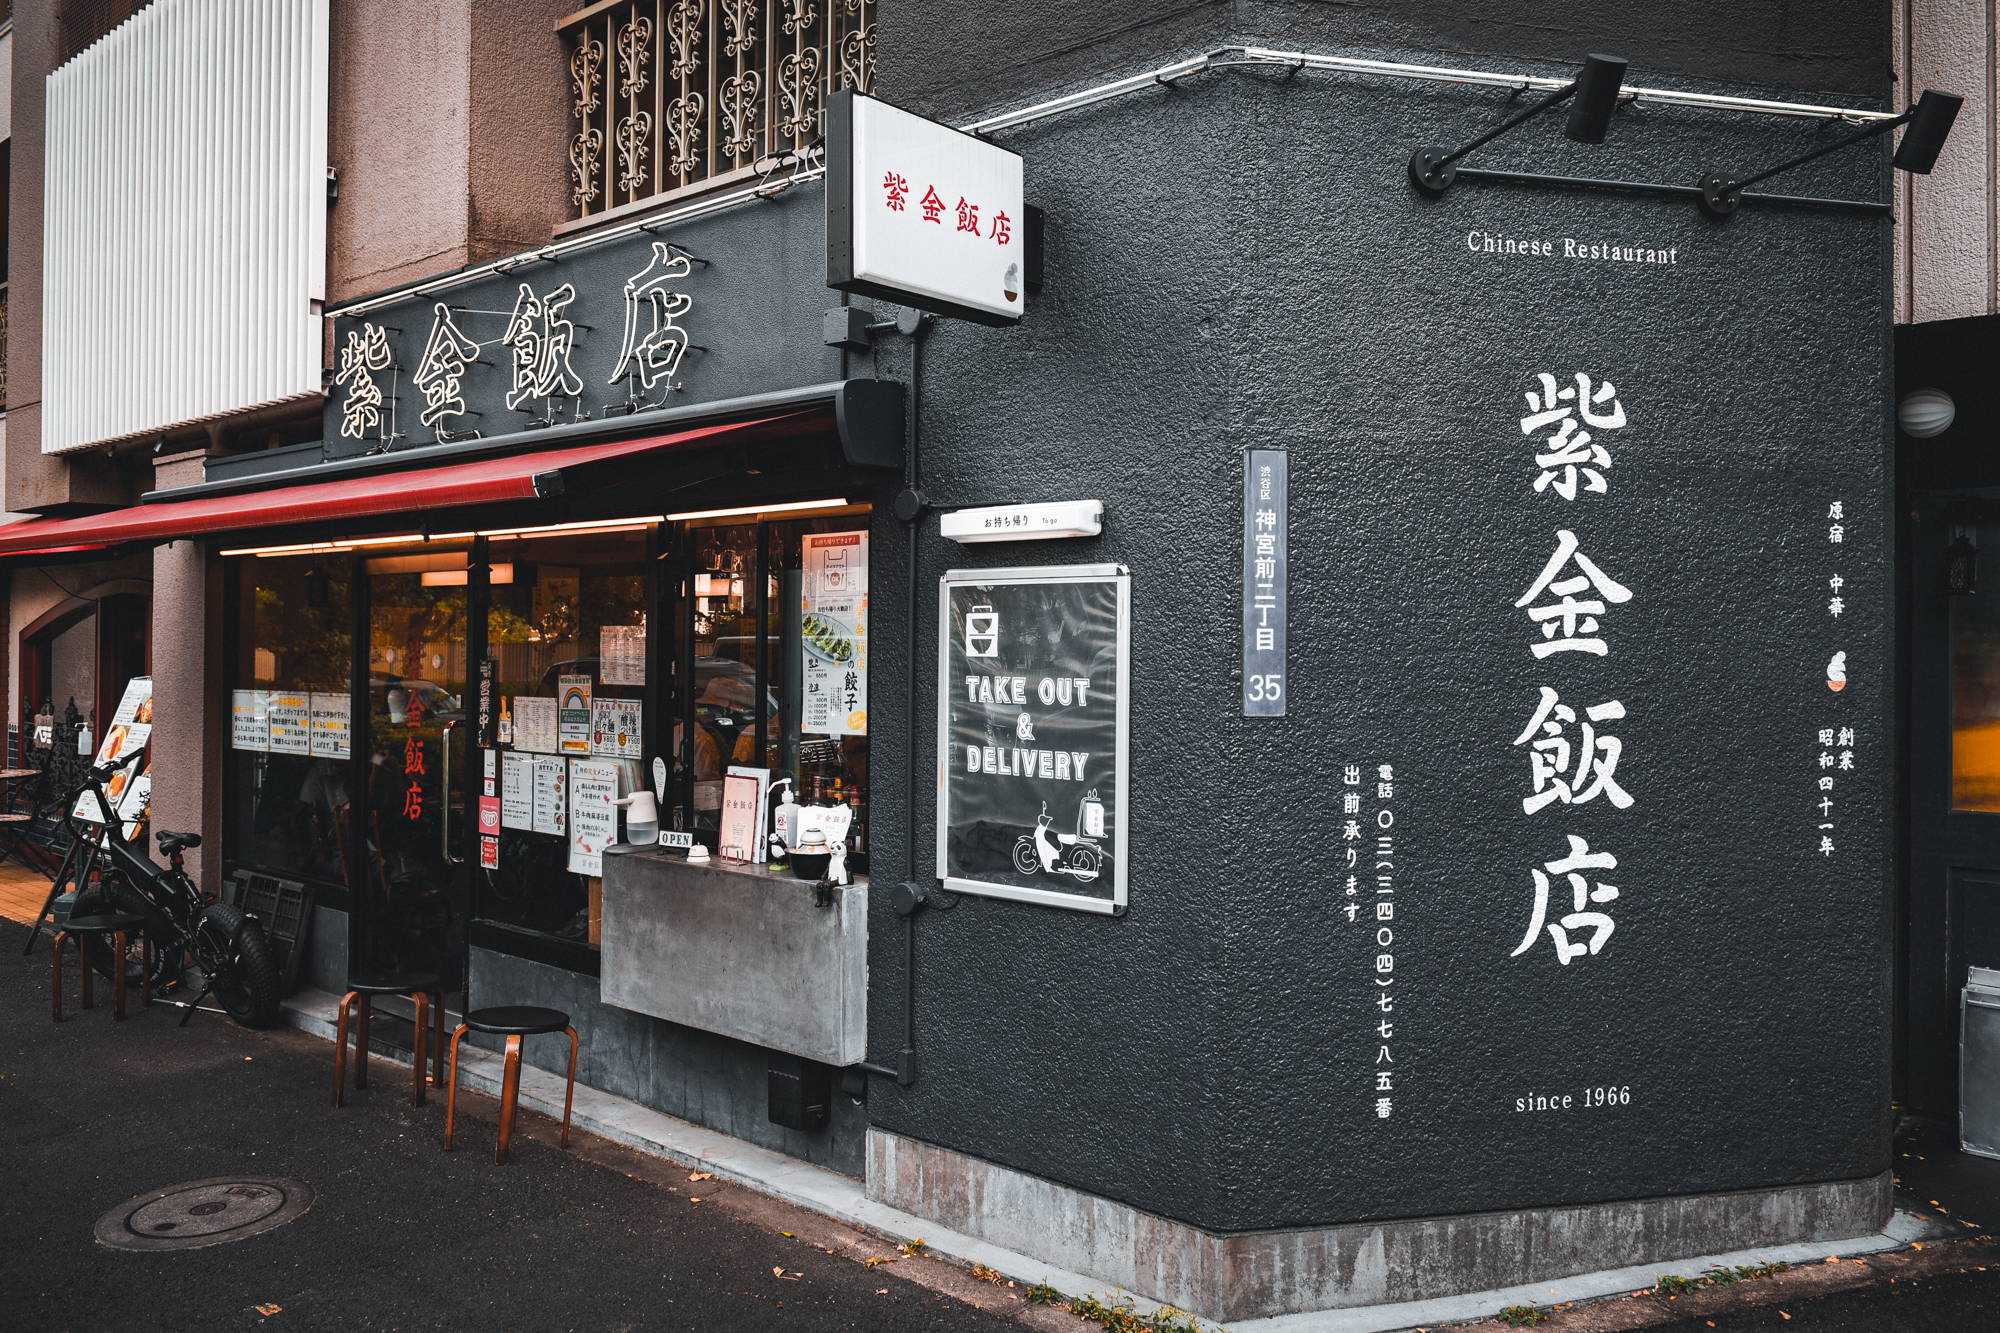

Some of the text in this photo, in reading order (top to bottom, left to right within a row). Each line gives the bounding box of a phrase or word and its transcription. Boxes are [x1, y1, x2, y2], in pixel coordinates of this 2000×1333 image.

[883, 171, 1011, 245] 紫金飯店
[1467, 231, 1678, 264] Chinese Restaurant
[336, 241, 692, 438] 紫金飯店
[1260, 466, 1272, 500] 渋谷区
[984, 515, 1029, 528] お持ち帰り
[1827, 501, 1845, 618] 原宿 中華
[1254, 508, 1276, 651] 神宮前二丁目
[1510, 372, 1635, 965] 紫金飯店
[965, 675, 1090, 707] TAKE OUT
[1249, 674, 1281, 702] 35
[1016, 712, 1035, 741] &
[966, 744, 1089, 782] DELIVERY
[1837, 727, 1855, 770] 創業
[1818, 728, 1835, 856] 昭和四十一年
[662, 833, 690, 846] OPEN
[1343, 765, 1361, 922] 出前承ります
[1516, 1086, 1631, 1112] since 1966
